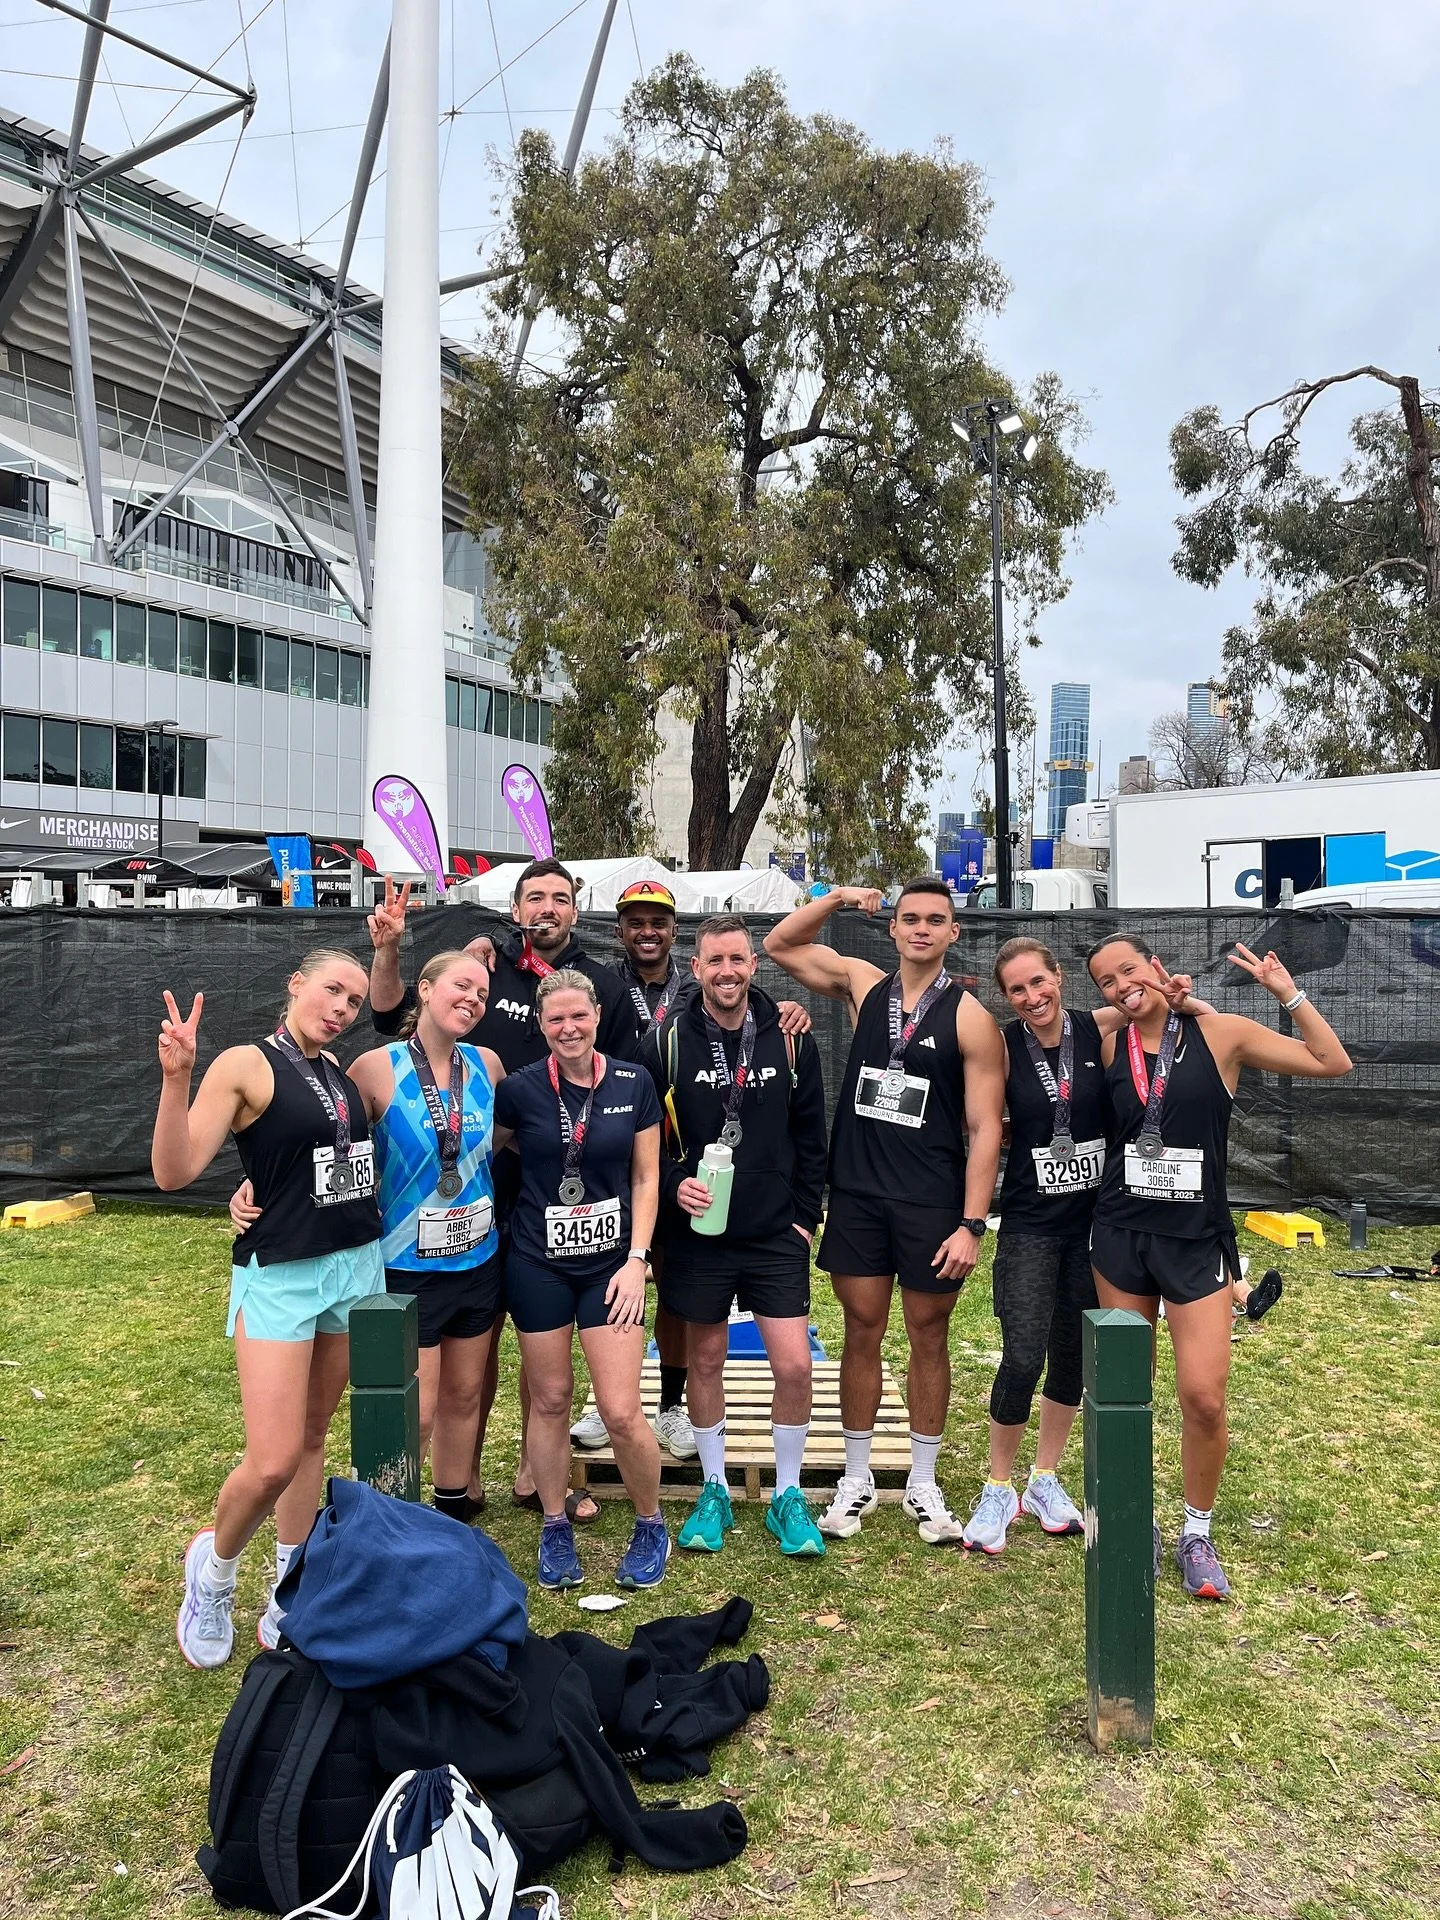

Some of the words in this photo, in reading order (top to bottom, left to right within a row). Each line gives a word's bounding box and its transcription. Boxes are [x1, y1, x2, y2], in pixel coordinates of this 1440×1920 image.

[40, 816, 159, 841] MERCHANDISE
[518, 805, 538, 842] Premature
[66, 836, 103, 848] LIMITED
[105, 838, 134, 850] STOCK
[397, 820, 425, 858] Premature
[889, 998, 897, 1040] FINISHER
[710, 1041, 726, 1086] FINISHER
[1034, 1061, 1058, 1103] FINISHER
[422, 1084, 444, 1132] FINISHER
[603, 1105, 633, 1115] KANE
[873, 1095, 900, 1111] 22608
[858, 1105, 895, 1120] MELBOURNE
[895, 1114, 914, 1125] 2025
[1043, 1153, 1100, 1185] 32991
[1141, 1160, 1181, 1175] CAROLINE
[1045, 1182, 1087, 1194] MELBOURNE
[1147, 1174, 1175, 1188] 30656
[323, 1190, 361, 1205] MELBOURNE
[1130, 1186, 1173, 1199] MELBOURNE
[1173, 1191, 1195, 1200] 2025
[446, 1217, 474, 1234] ABBEY
[553, 1214, 616, 1247] 34548
[446, 1230, 471, 1246] 31852
[424, 1243, 469, 1258] MELBOURNE
[554, 1244, 599, 1257] MELBOURNE
[599, 1240, 616, 1252] 2025
